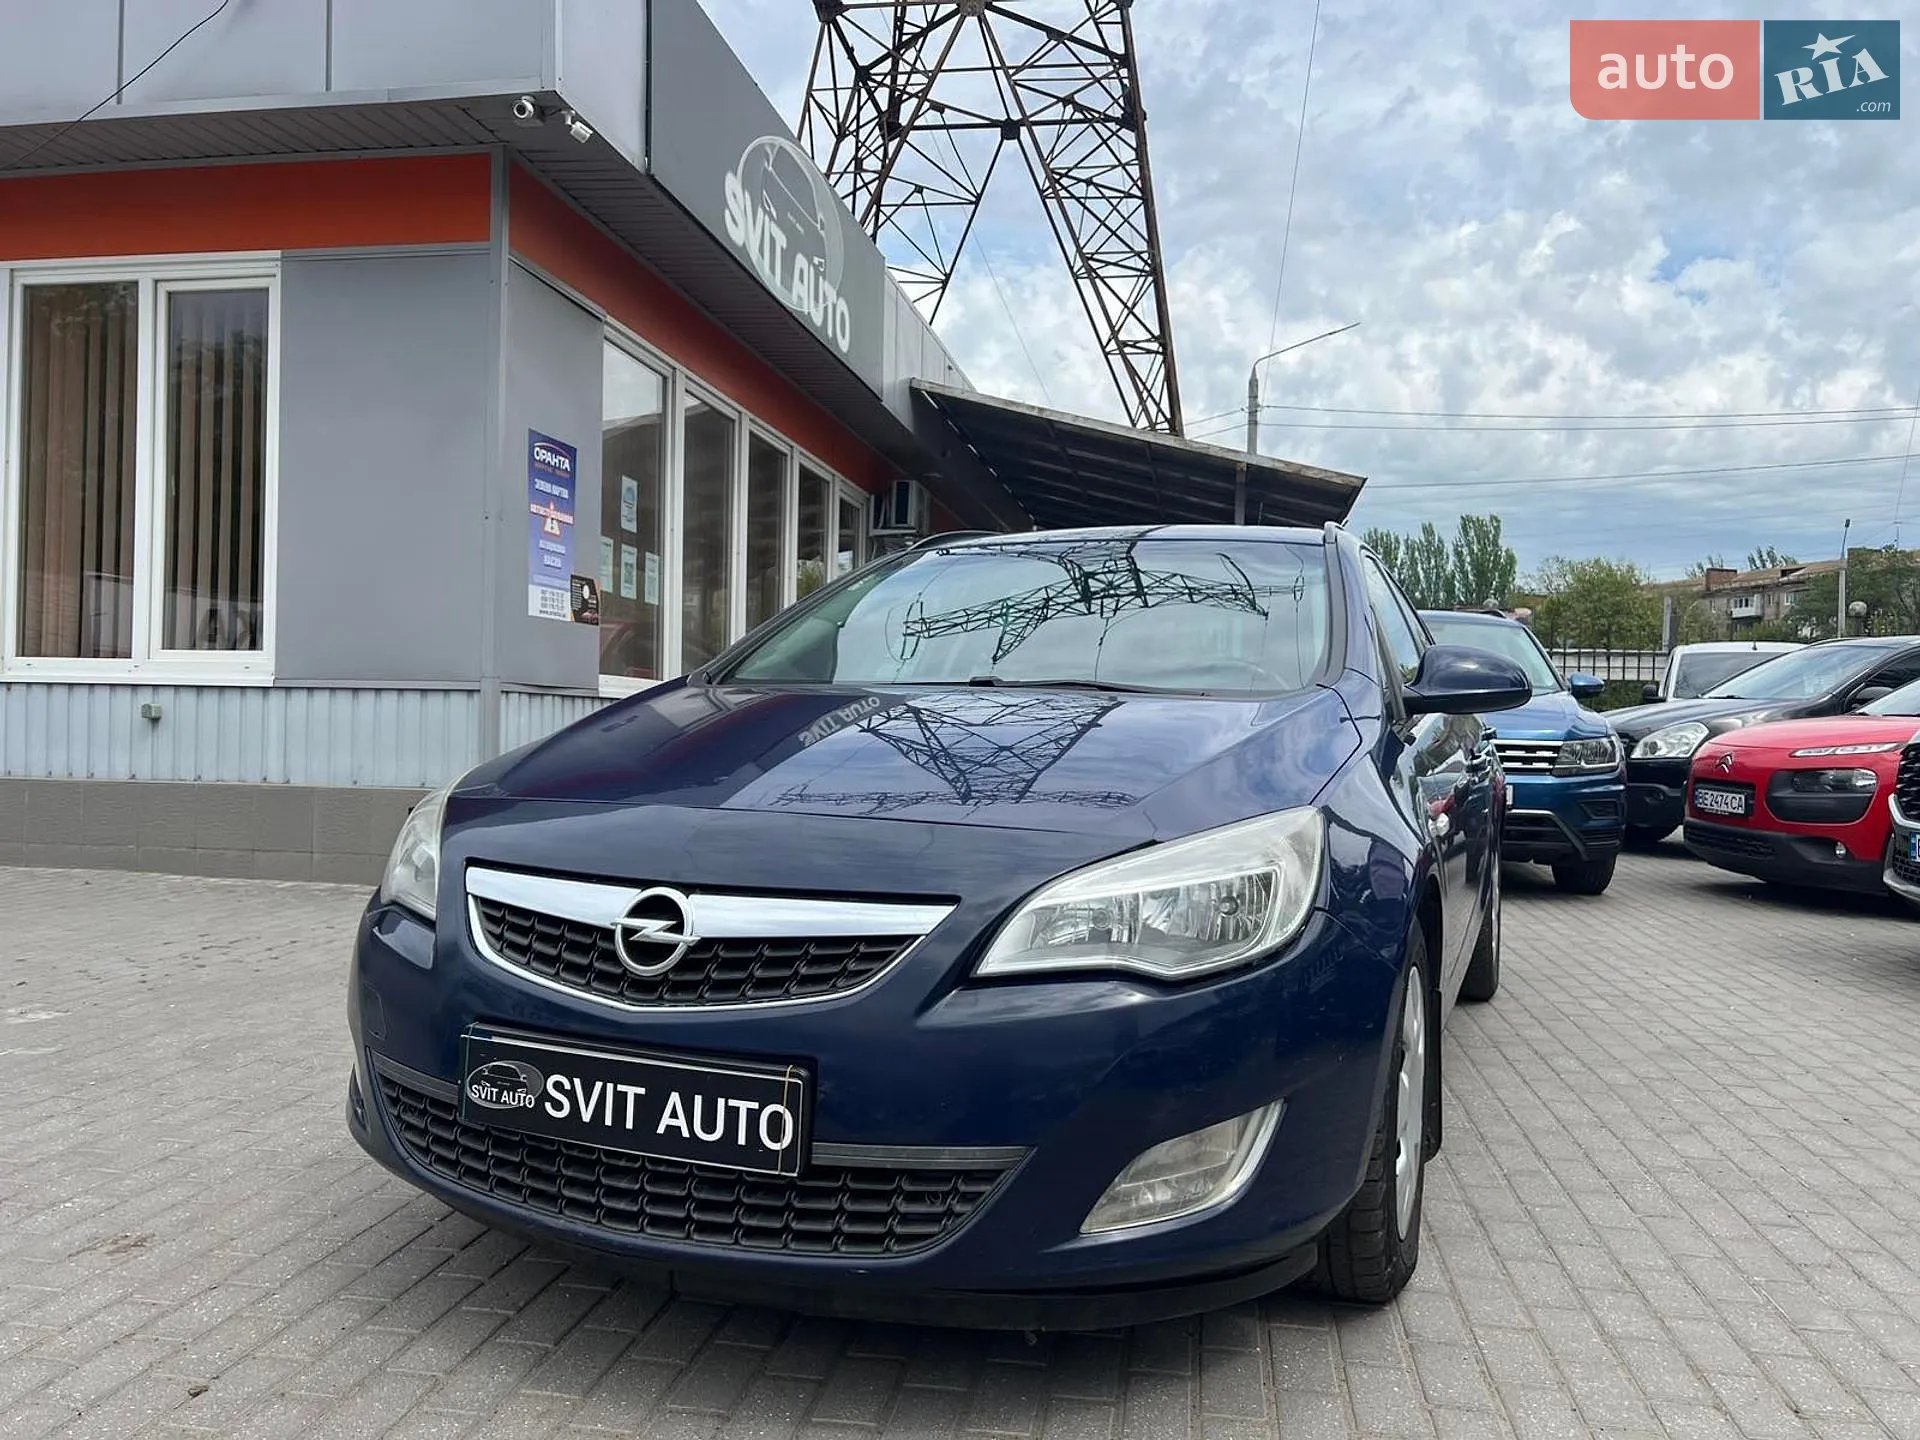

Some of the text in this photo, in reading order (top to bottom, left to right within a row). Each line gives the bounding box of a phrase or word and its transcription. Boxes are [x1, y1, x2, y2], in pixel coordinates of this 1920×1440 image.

[724, 170, 851, 353] SVIT AUTO
[471, 1084, 535, 1109] SVIT AUTO
[544, 1074, 794, 1151] SVIT AUTO
